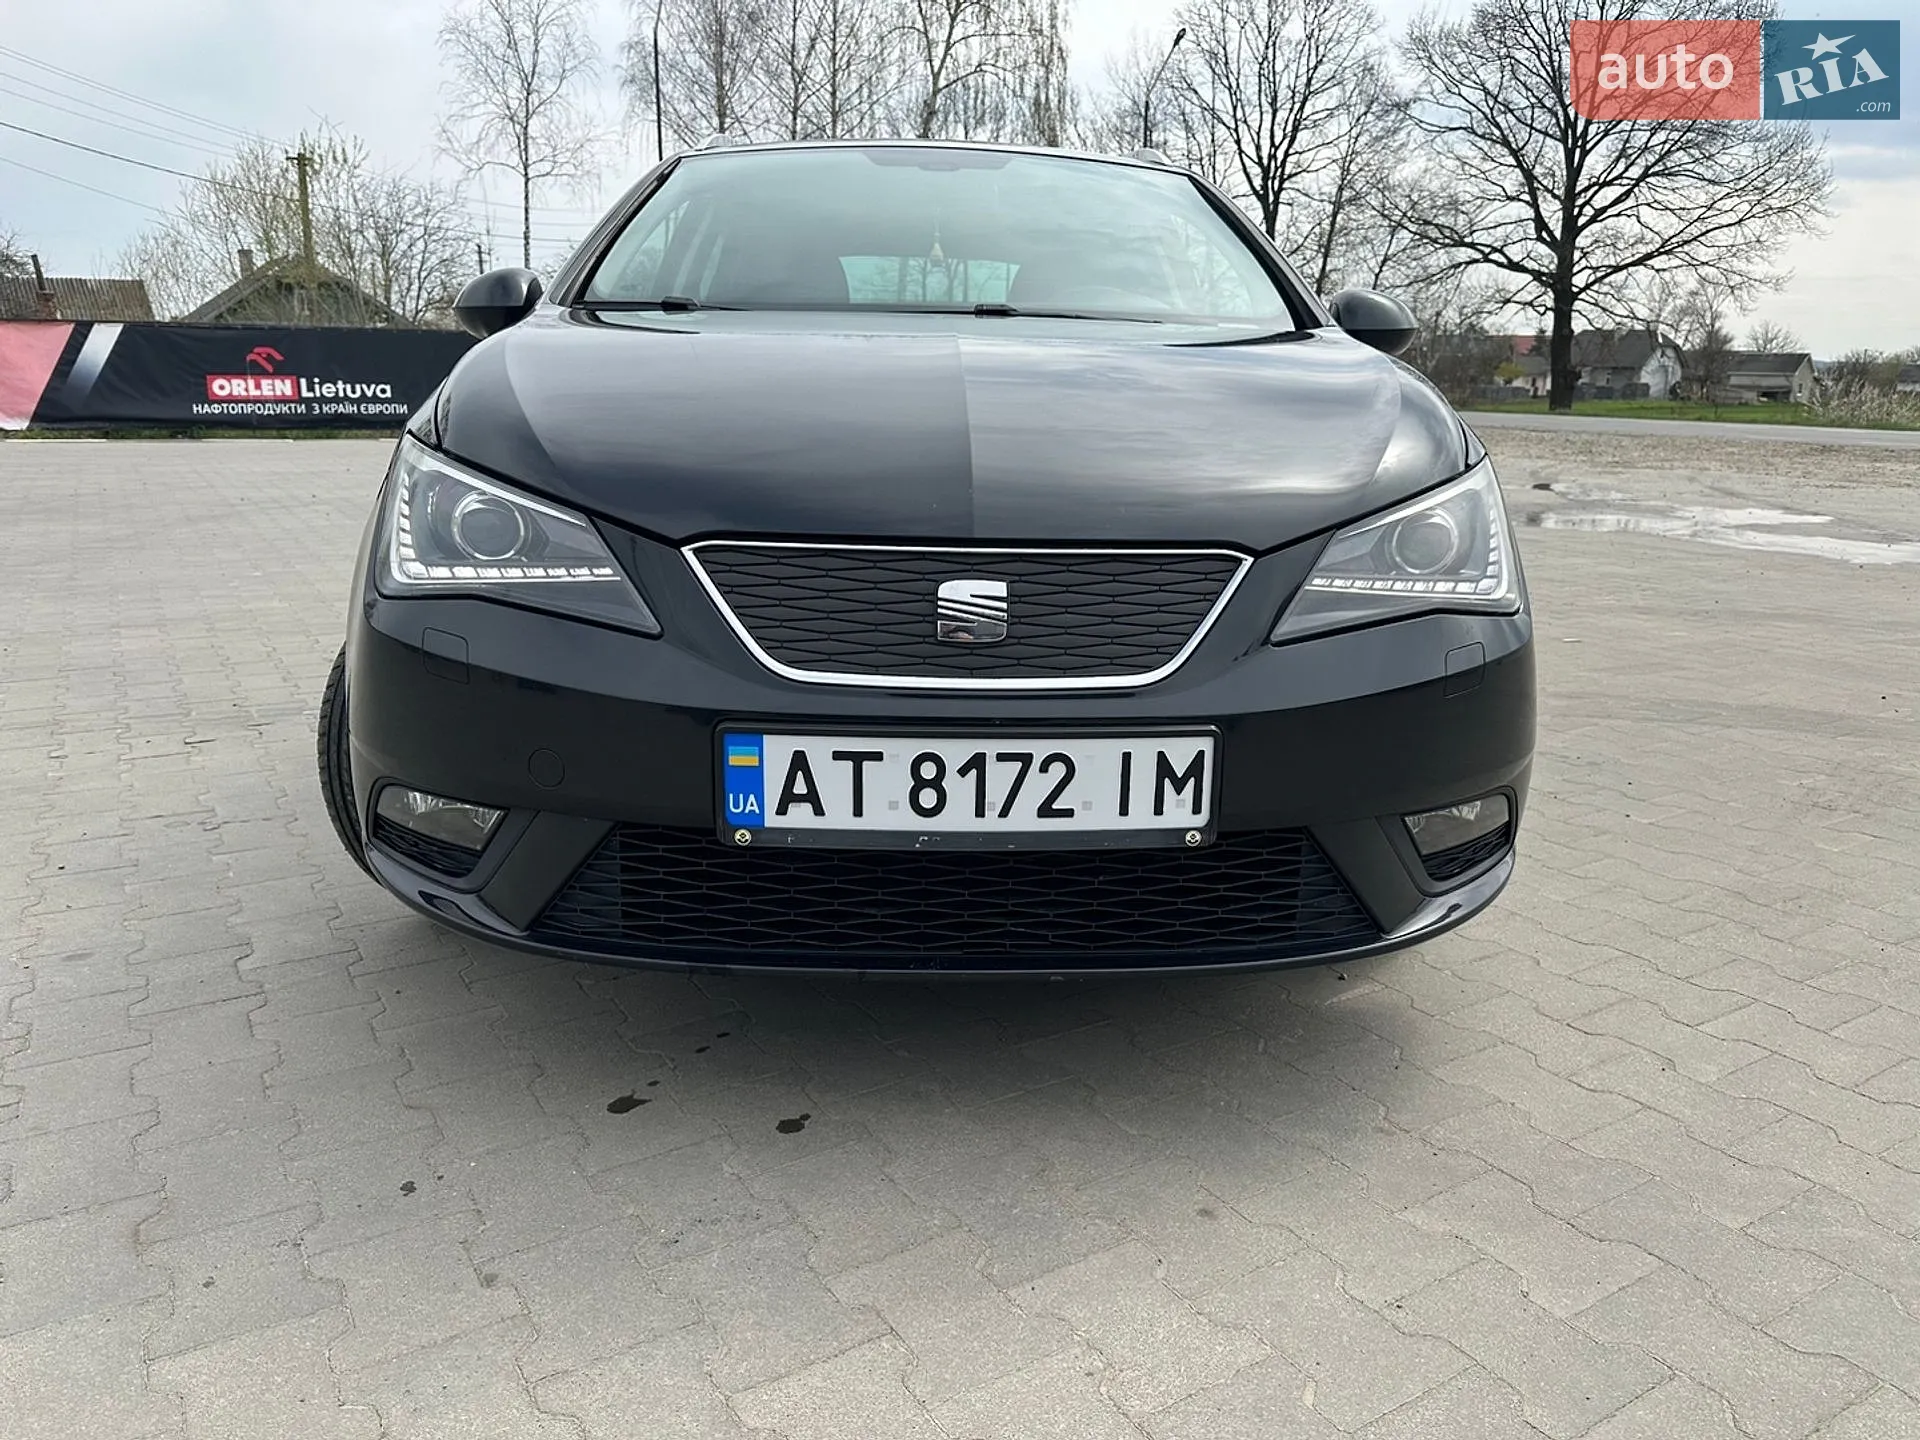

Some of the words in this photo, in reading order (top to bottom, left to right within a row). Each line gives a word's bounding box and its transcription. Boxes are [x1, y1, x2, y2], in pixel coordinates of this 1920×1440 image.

[211, 377, 293, 397] ORLEN
[299, 377, 392, 399] Lietuva
[193, 402, 307, 416] НАФТОПРОДУКТИ
[312, 403, 321, 415] З
[322, 402, 358, 415] КРАЇН
[359, 403, 408, 415] ЄВРОПИ
[775, 749, 885, 818] AT
[908, 750, 1077, 819] 8172
[1118, 749, 1206, 817] IM
[728, 793, 760, 815] UA
